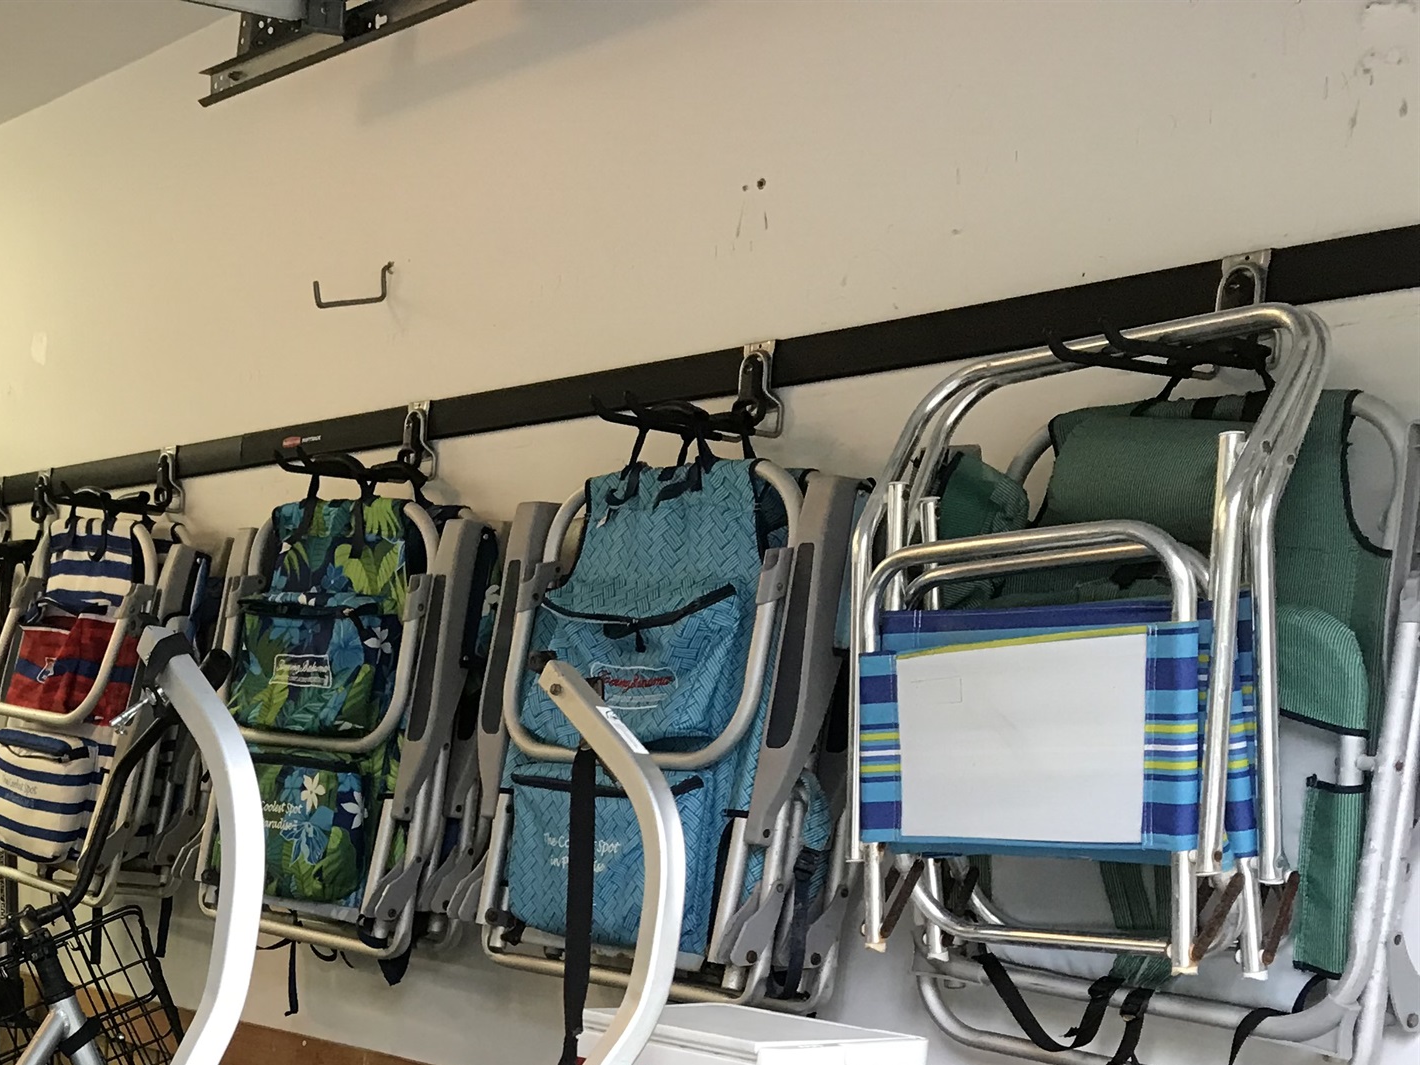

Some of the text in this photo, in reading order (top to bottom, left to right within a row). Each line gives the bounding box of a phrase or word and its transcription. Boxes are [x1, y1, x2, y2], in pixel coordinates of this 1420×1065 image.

[285, 802, 303, 816] Spot
[264, 817, 293, 831] aradise
[596, 839, 621, 857] Spot
